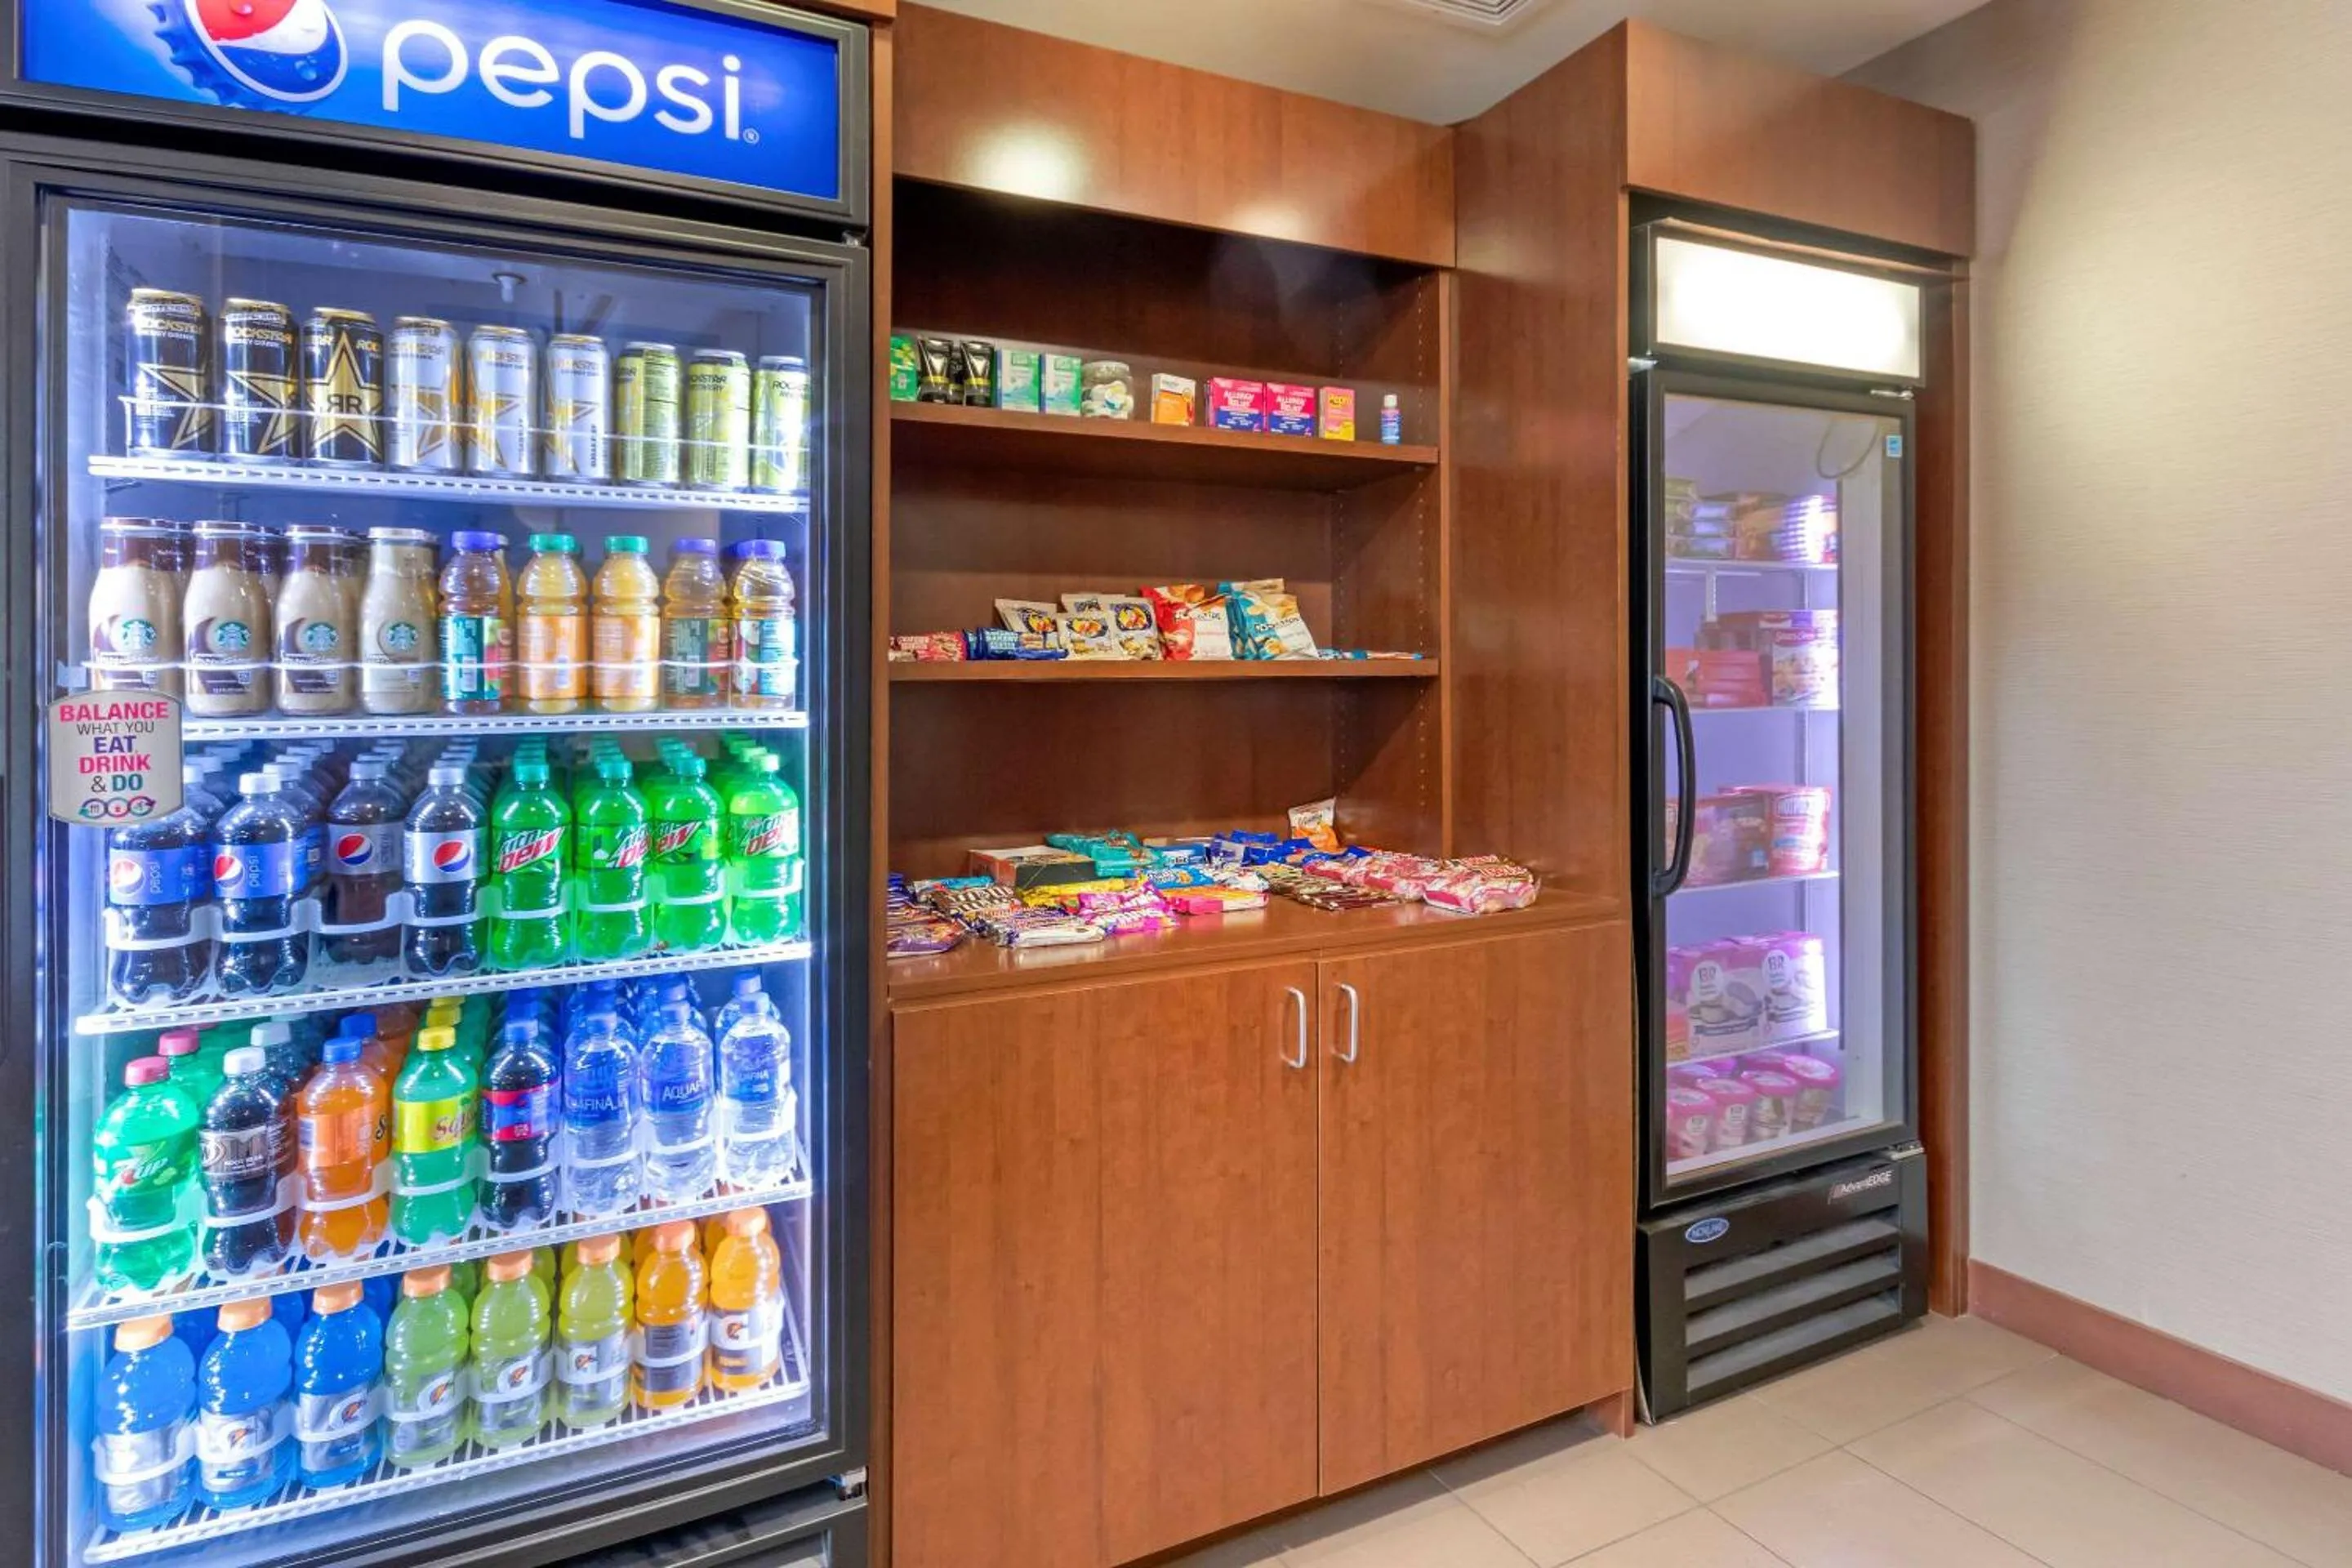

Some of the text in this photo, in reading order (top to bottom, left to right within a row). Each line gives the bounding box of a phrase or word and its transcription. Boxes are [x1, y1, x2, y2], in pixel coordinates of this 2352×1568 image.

[382, 20, 740, 140] pepsi
[60, 702, 169, 722] BALANCE
[77, 720, 154, 735] WHAT YOU
[94, 736, 136, 753] EAT
[78, 754, 151, 774] DRINK
[91, 773, 144, 792] & DO
